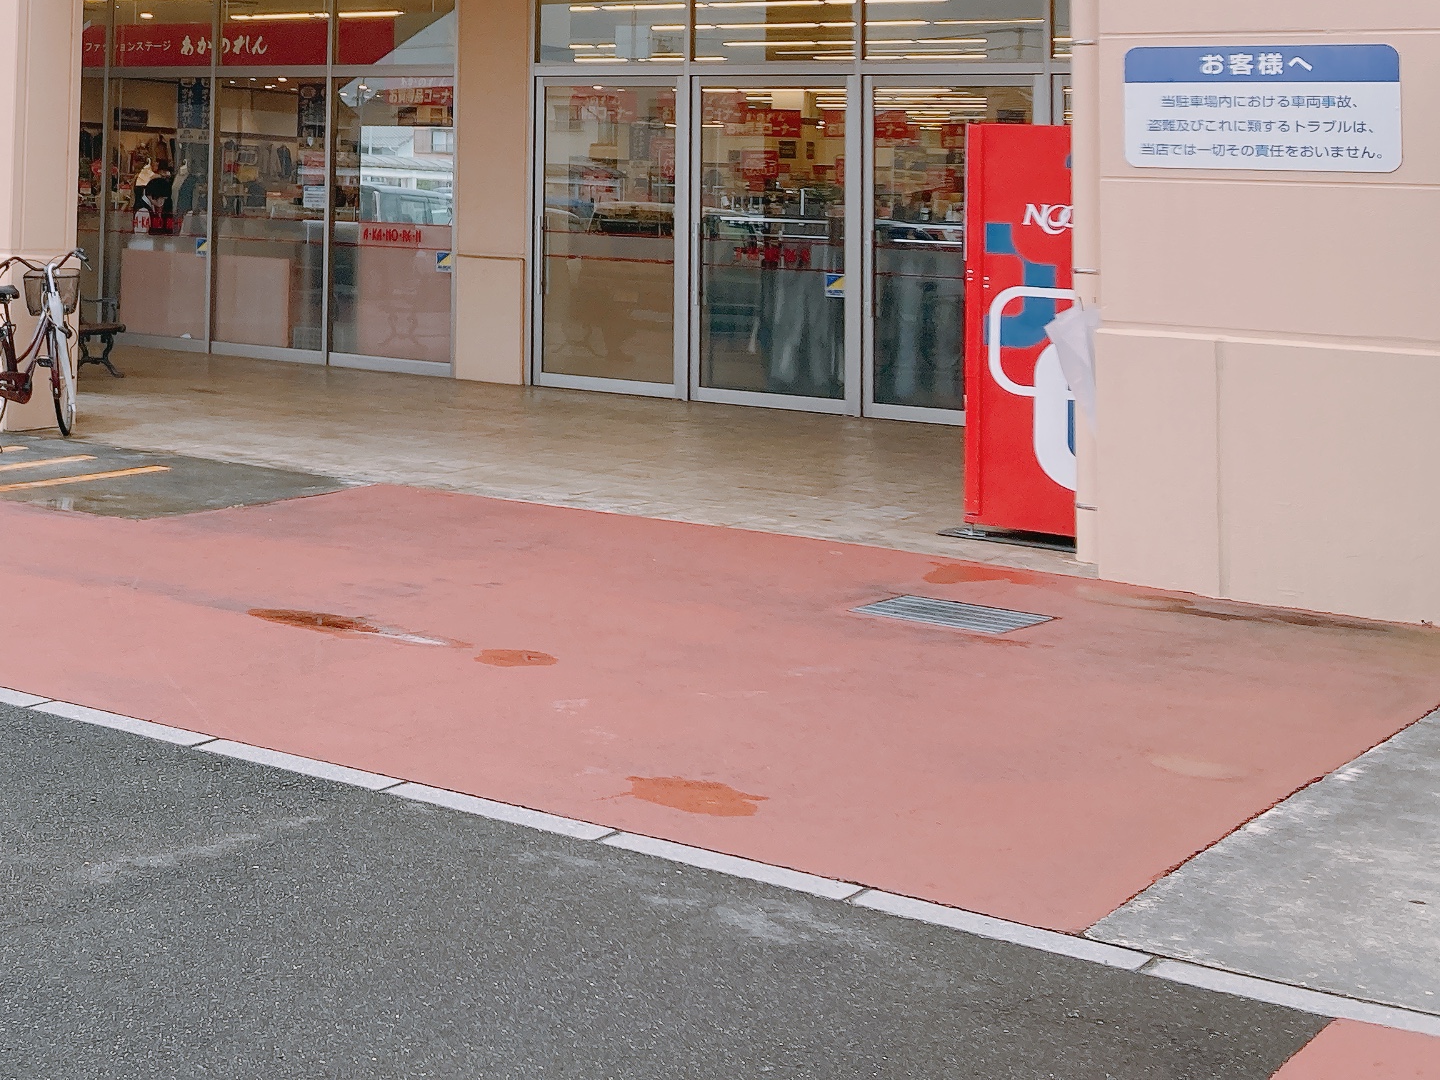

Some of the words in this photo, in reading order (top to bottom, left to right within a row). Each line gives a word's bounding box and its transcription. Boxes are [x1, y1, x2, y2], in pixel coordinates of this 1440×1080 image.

[85, 40, 171, 53] ファョンステージ
[1200, 52, 1313, 76] お客様へ
[1160, 95, 1359, 109] 当駐車場内における車両事故、
[1146, 119, 1375, 134] 盗難及びこれに類するトラブルは、
